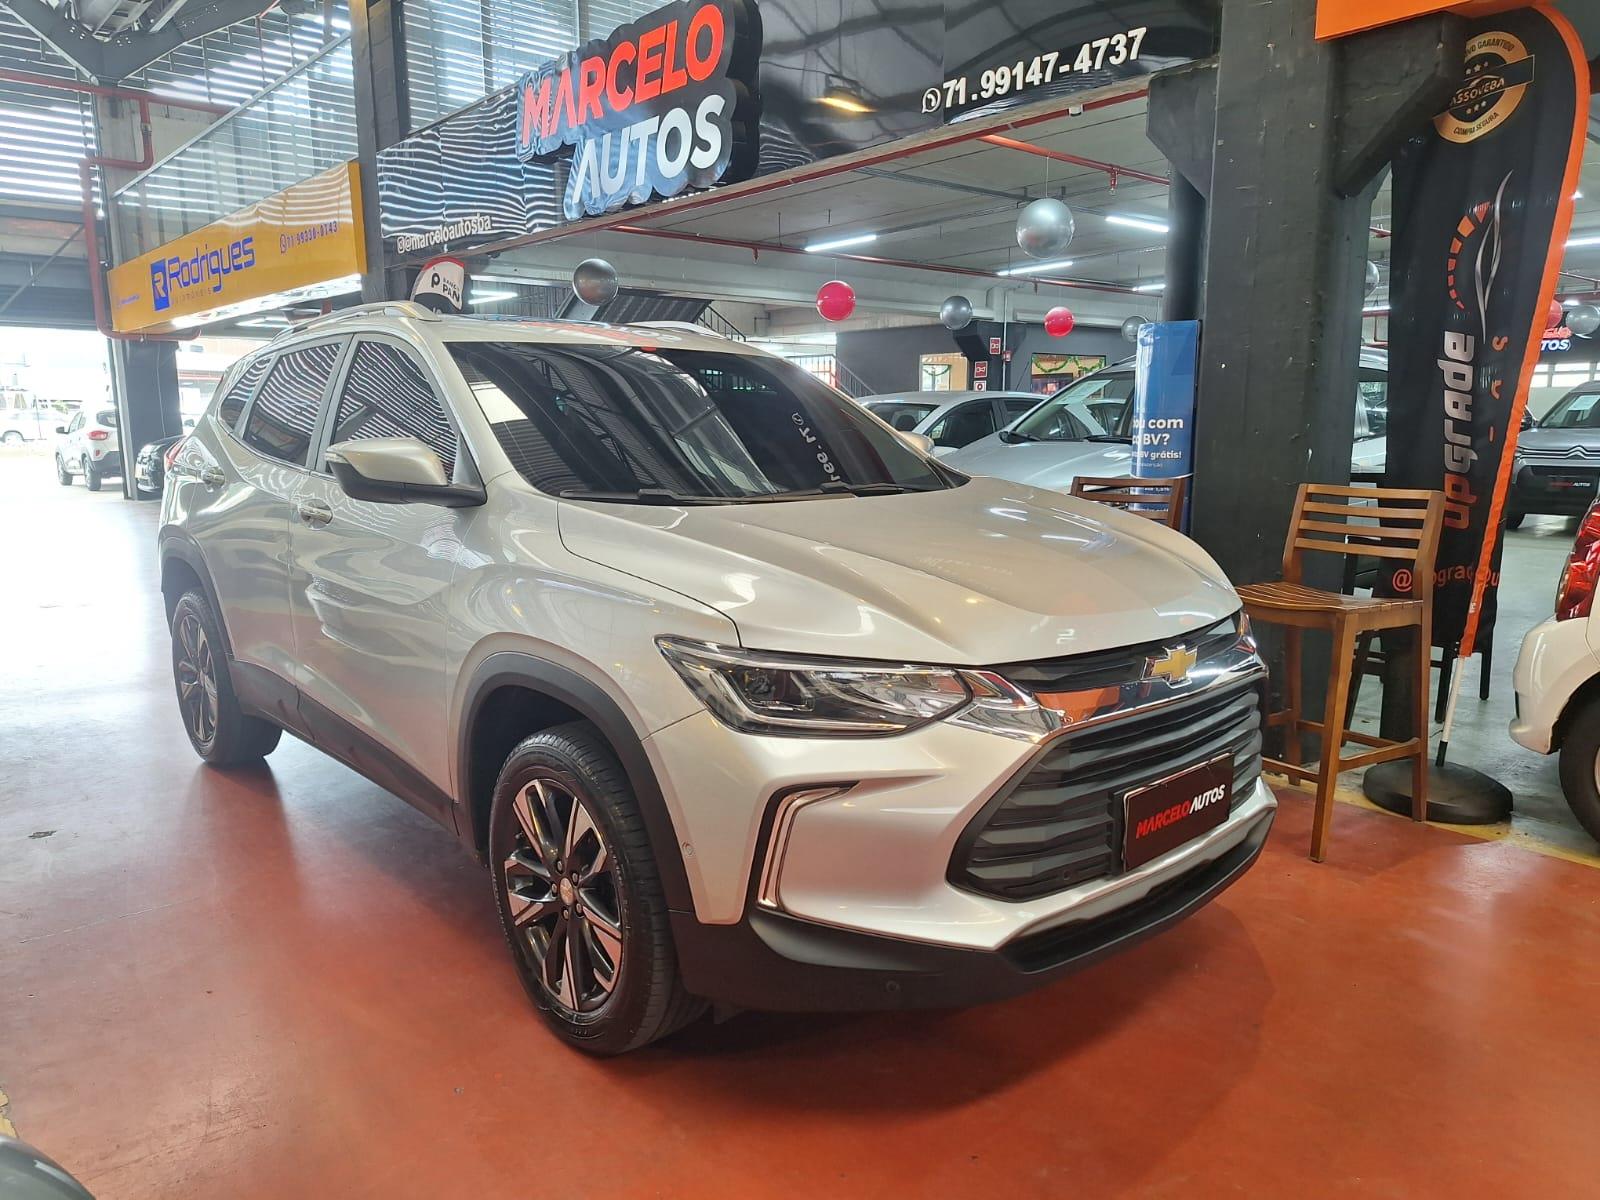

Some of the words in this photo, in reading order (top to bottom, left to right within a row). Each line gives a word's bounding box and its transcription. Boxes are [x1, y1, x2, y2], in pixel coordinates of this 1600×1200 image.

[521, 4, 725, 145] MARCELO
[943, 27, 1147, 107] 71.99147-4737
[1475, 112, 1500, 131] SEGURA
[573, 95, 726, 203] AUTOS
[403, 212, 492, 251] @marceloautosba
[167, 236, 255, 293] Rodrigues
[443, 284, 460, 302] PAN
[1541, 339, 1570, 351] TOS
[1148, 418, 1184, 429] com
[1143, 433, 1170, 446] BV?
[1150, 450, 1182, 461] grátis!
